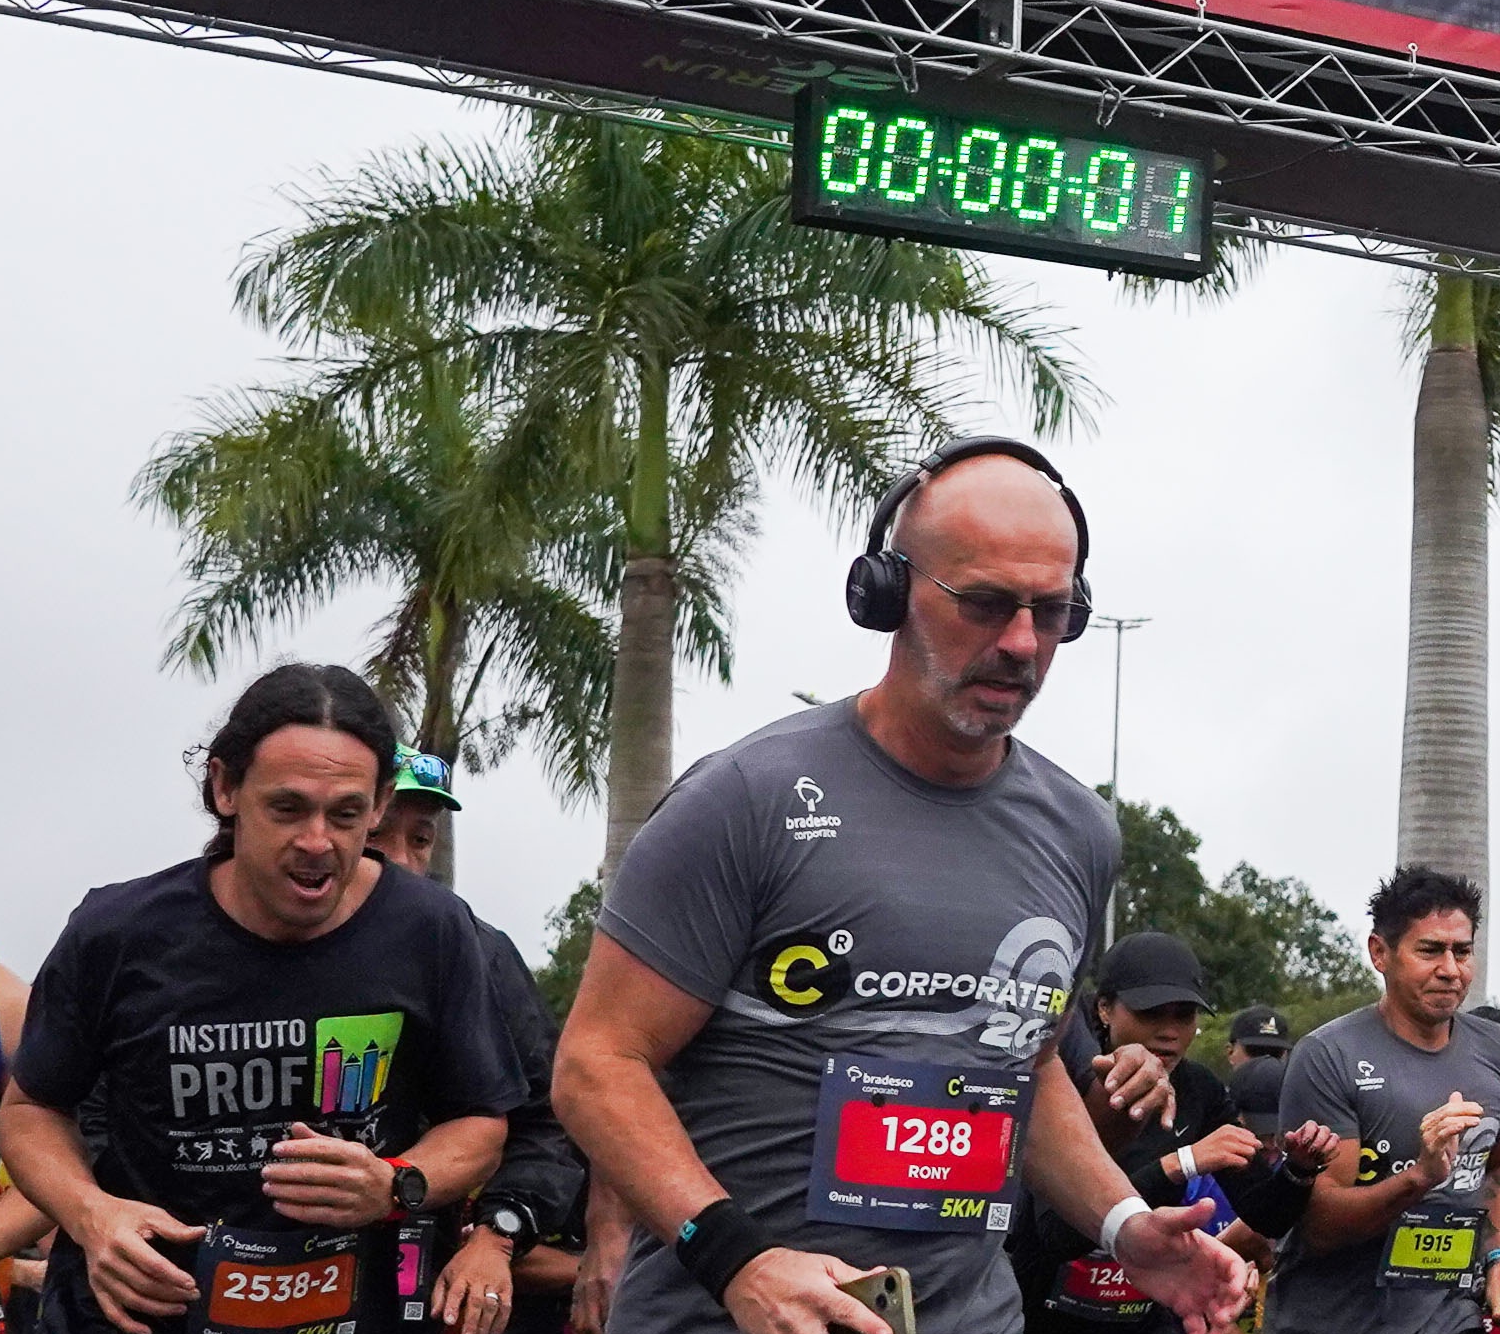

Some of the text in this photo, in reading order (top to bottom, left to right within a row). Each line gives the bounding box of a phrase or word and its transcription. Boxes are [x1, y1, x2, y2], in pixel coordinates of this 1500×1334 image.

[820, 107, 1190, 235] 00:00:01
[786, 814, 841, 829] bradesco
[794, 829, 837, 841] corporate
[169, 1019, 306, 1054] INSTITUTO
[170, 1057, 308, 1117] PROF
[863, 1073, 914, 1088] bradesco
[862, 1085, 899, 1095] corporate
[882, 1116, 972, 1156] 1288
[908, 1165, 951, 1180] RONY
[828, 1190, 863, 1205] Omint
[940, 1198, 986, 1218] 5KM
[235, 1241, 277, 1254] bradesco
[1414, 1234, 1453, 1252] 1915
[223, 1265, 339, 1302] 2538-2
[1090, 1267, 1132, 1285] 124
[1100, 1289, 1126, 1297] PAULA
[1118, 1303, 1145, 1315] 5KM
